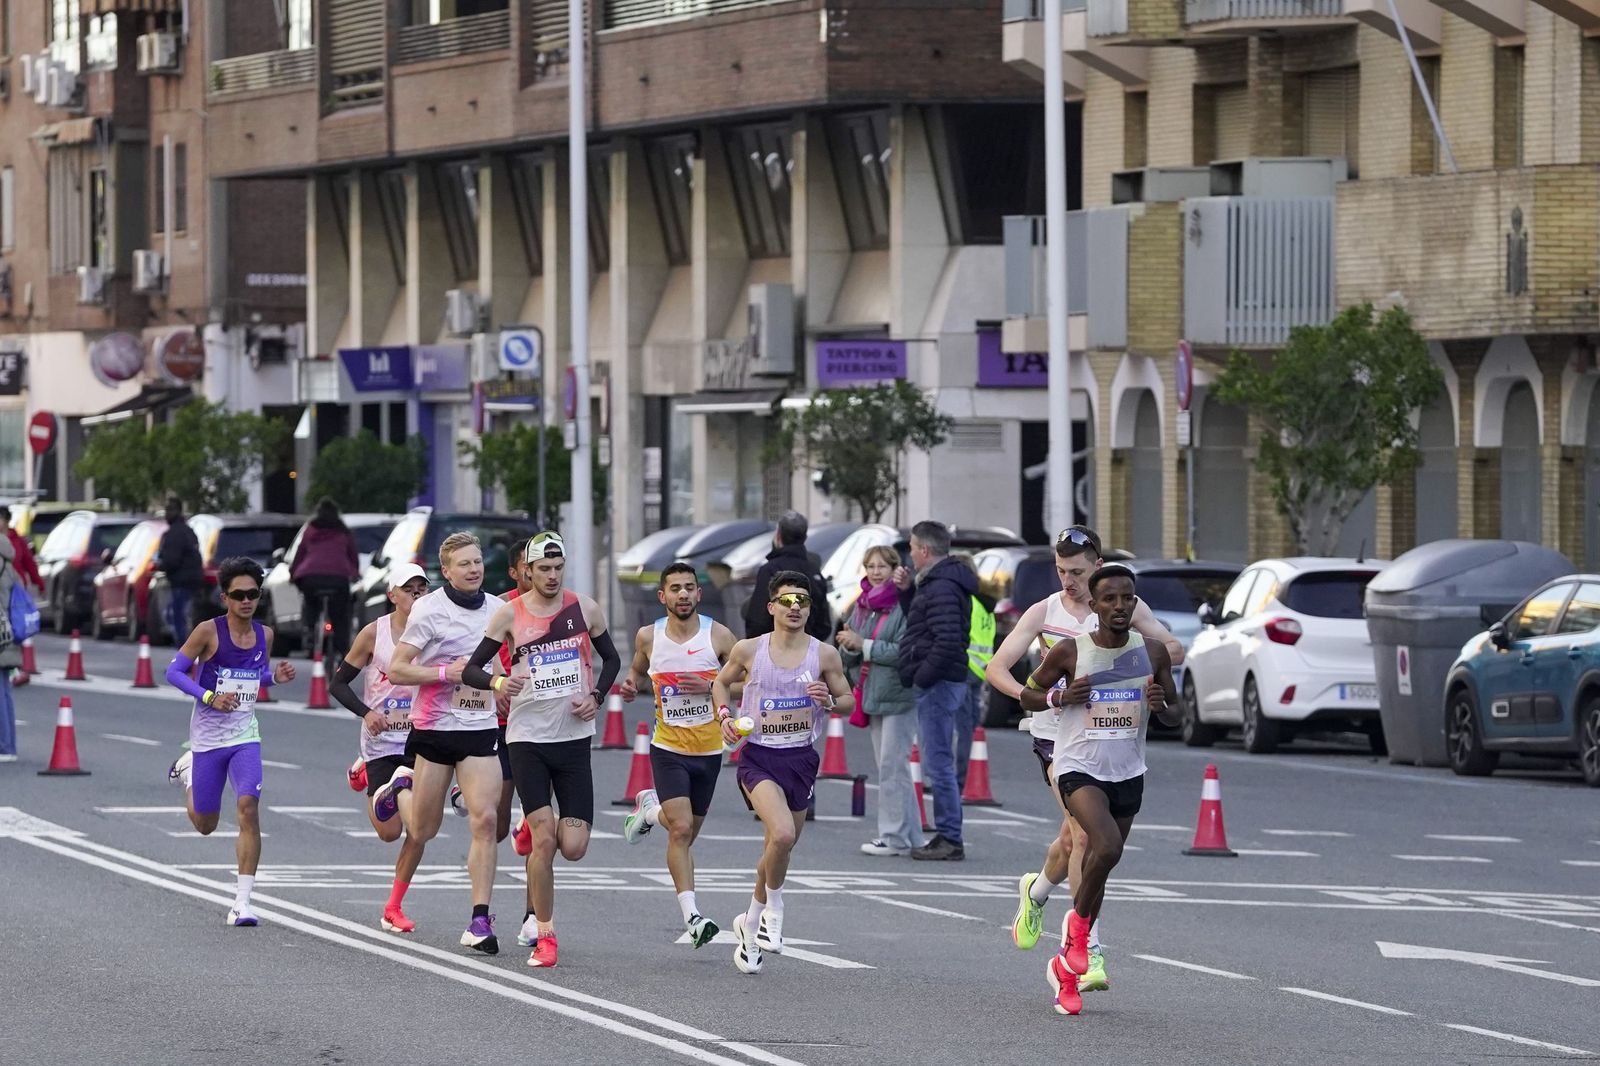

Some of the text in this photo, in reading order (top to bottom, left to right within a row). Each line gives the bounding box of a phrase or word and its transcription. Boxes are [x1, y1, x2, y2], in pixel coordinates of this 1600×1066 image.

[827, 348, 881, 359] TATTOO
[827, 362, 897, 374] PIERCING
[530, 636, 583, 655] SYNERGY
[546, 652, 574, 662] ZURICH
[534, 673, 579, 690] SZEMEREI
[1103, 691, 1135, 699] ZURICH
[459, 698, 486, 709] PATRIK
[778, 700, 806, 708] ZURICH
[666, 704, 709, 718] PACHECO
[761, 720, 811, 734] BOUKEBAL
[1092, 716, 1133, 728] TEDROS
